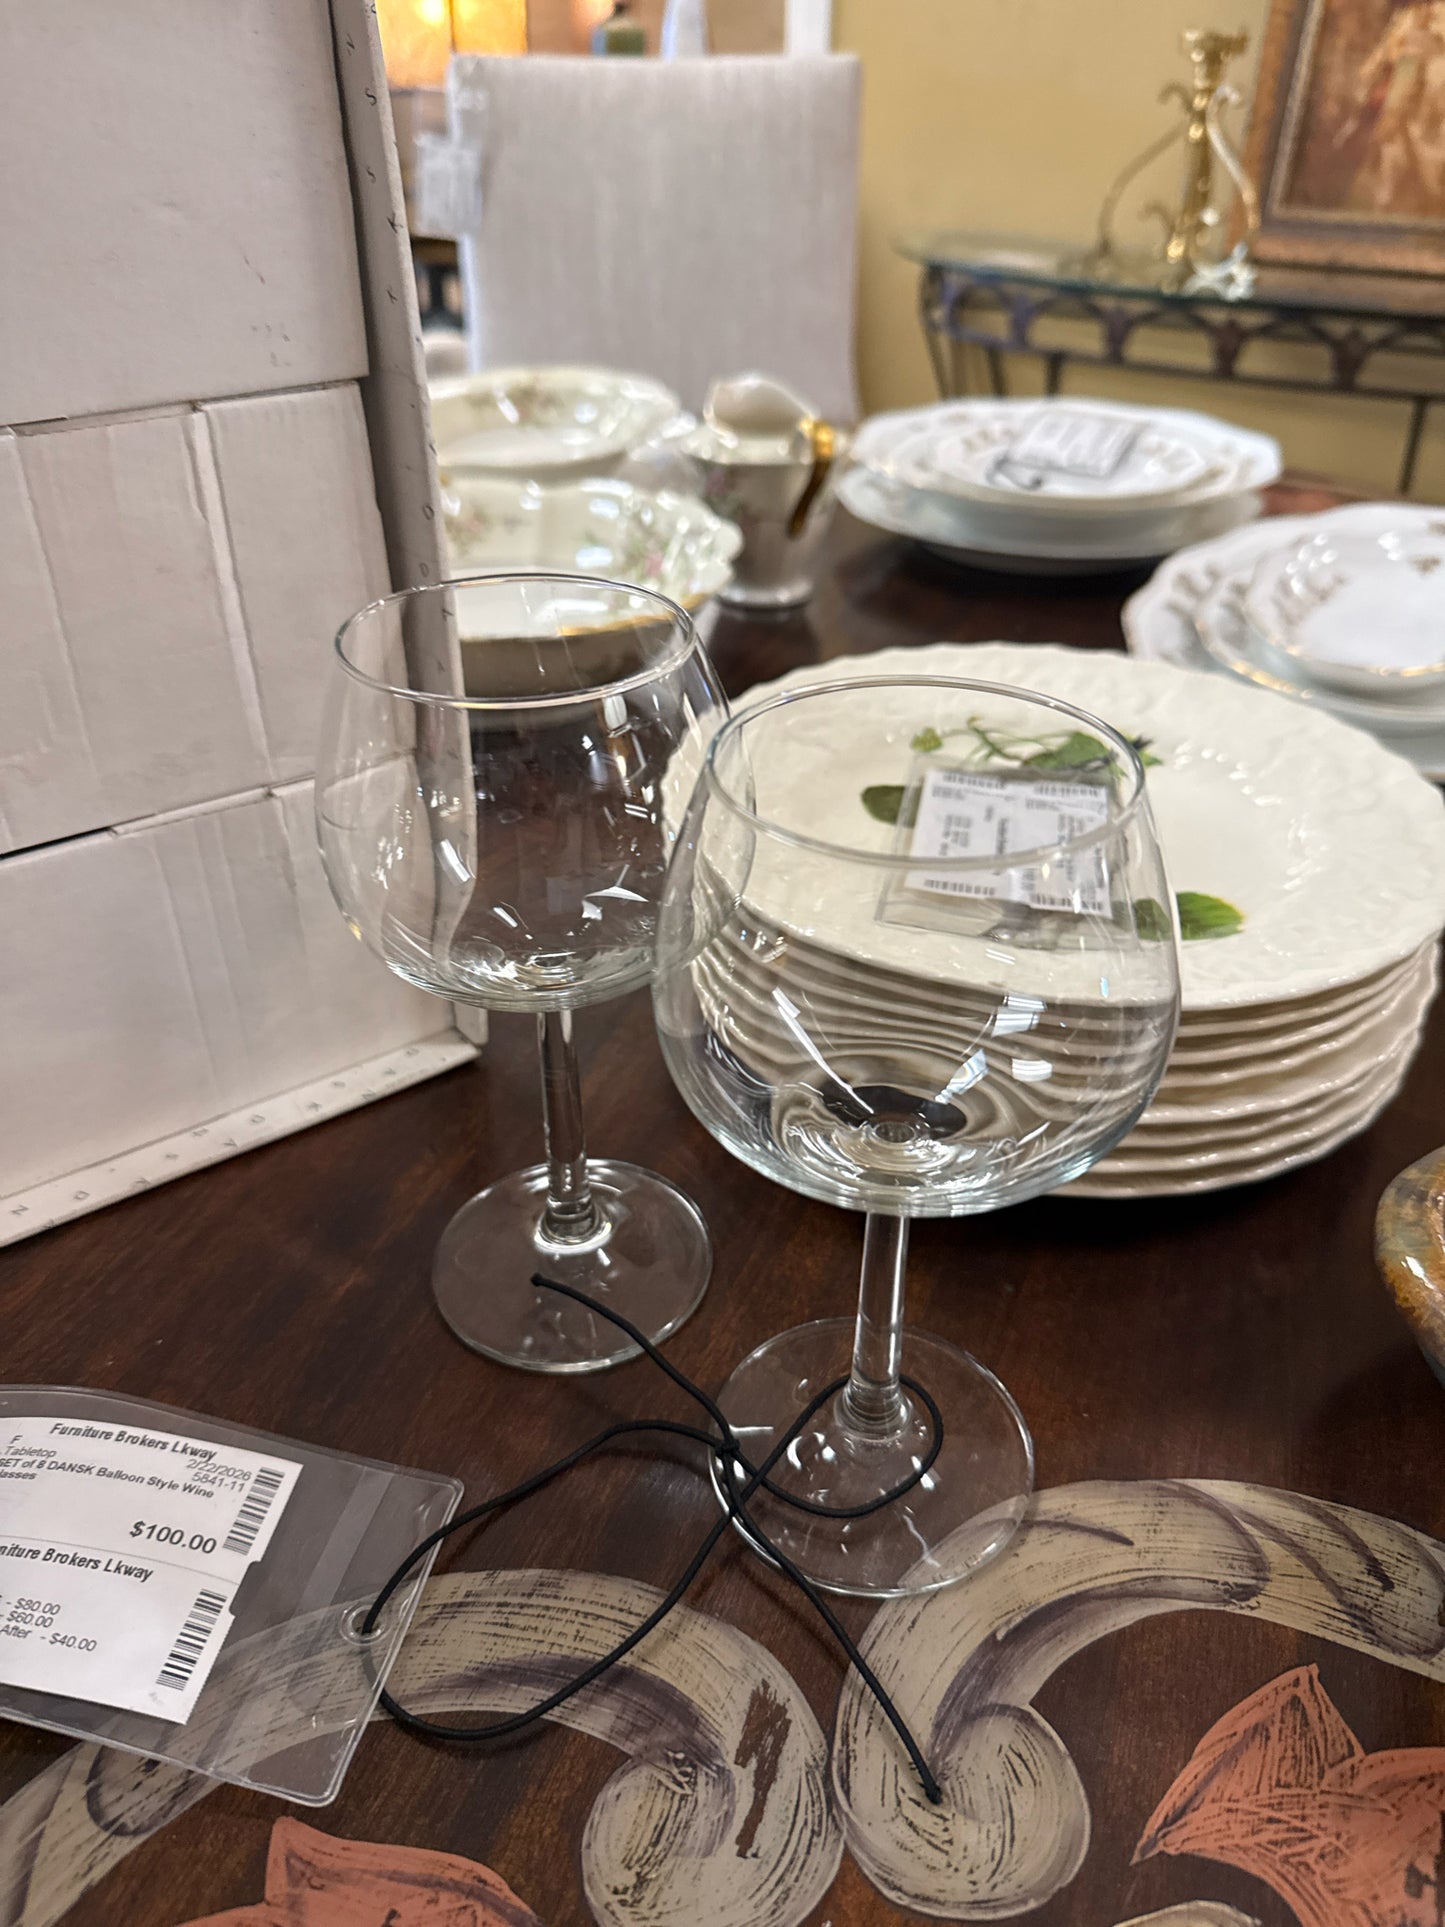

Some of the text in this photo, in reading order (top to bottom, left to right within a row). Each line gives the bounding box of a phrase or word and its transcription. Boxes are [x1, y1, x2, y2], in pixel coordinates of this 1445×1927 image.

[5, 1446, 57, 1459] Tabletop
[50, 1423, 217, 1463] Furniture Brokers Lkway
[21, 1459, 38, 1469] of
[47, 1460, 96, 1475] DANSK
[97, 1466, 145, 1485] Balloon
[147, 1476, 179, 1491] Style
[182, 1481, 214, 1499] Wine
[186, 1458, 253, 1481] 2/22/2026
[191, 1471, 246, 1493] 5841-11
[130, 1520, 217, 1554] $100.00
[42, 1548, 101, 1570] Brokers
[104, 1558, 154, 1583] Lkway
[6, 1610, 54, 1628] $60.00
[14, 1597, 61, 1616] $80.00
[0, 1624, 32, 1639] After
[49, 1632, 98, 1652] $40.00
